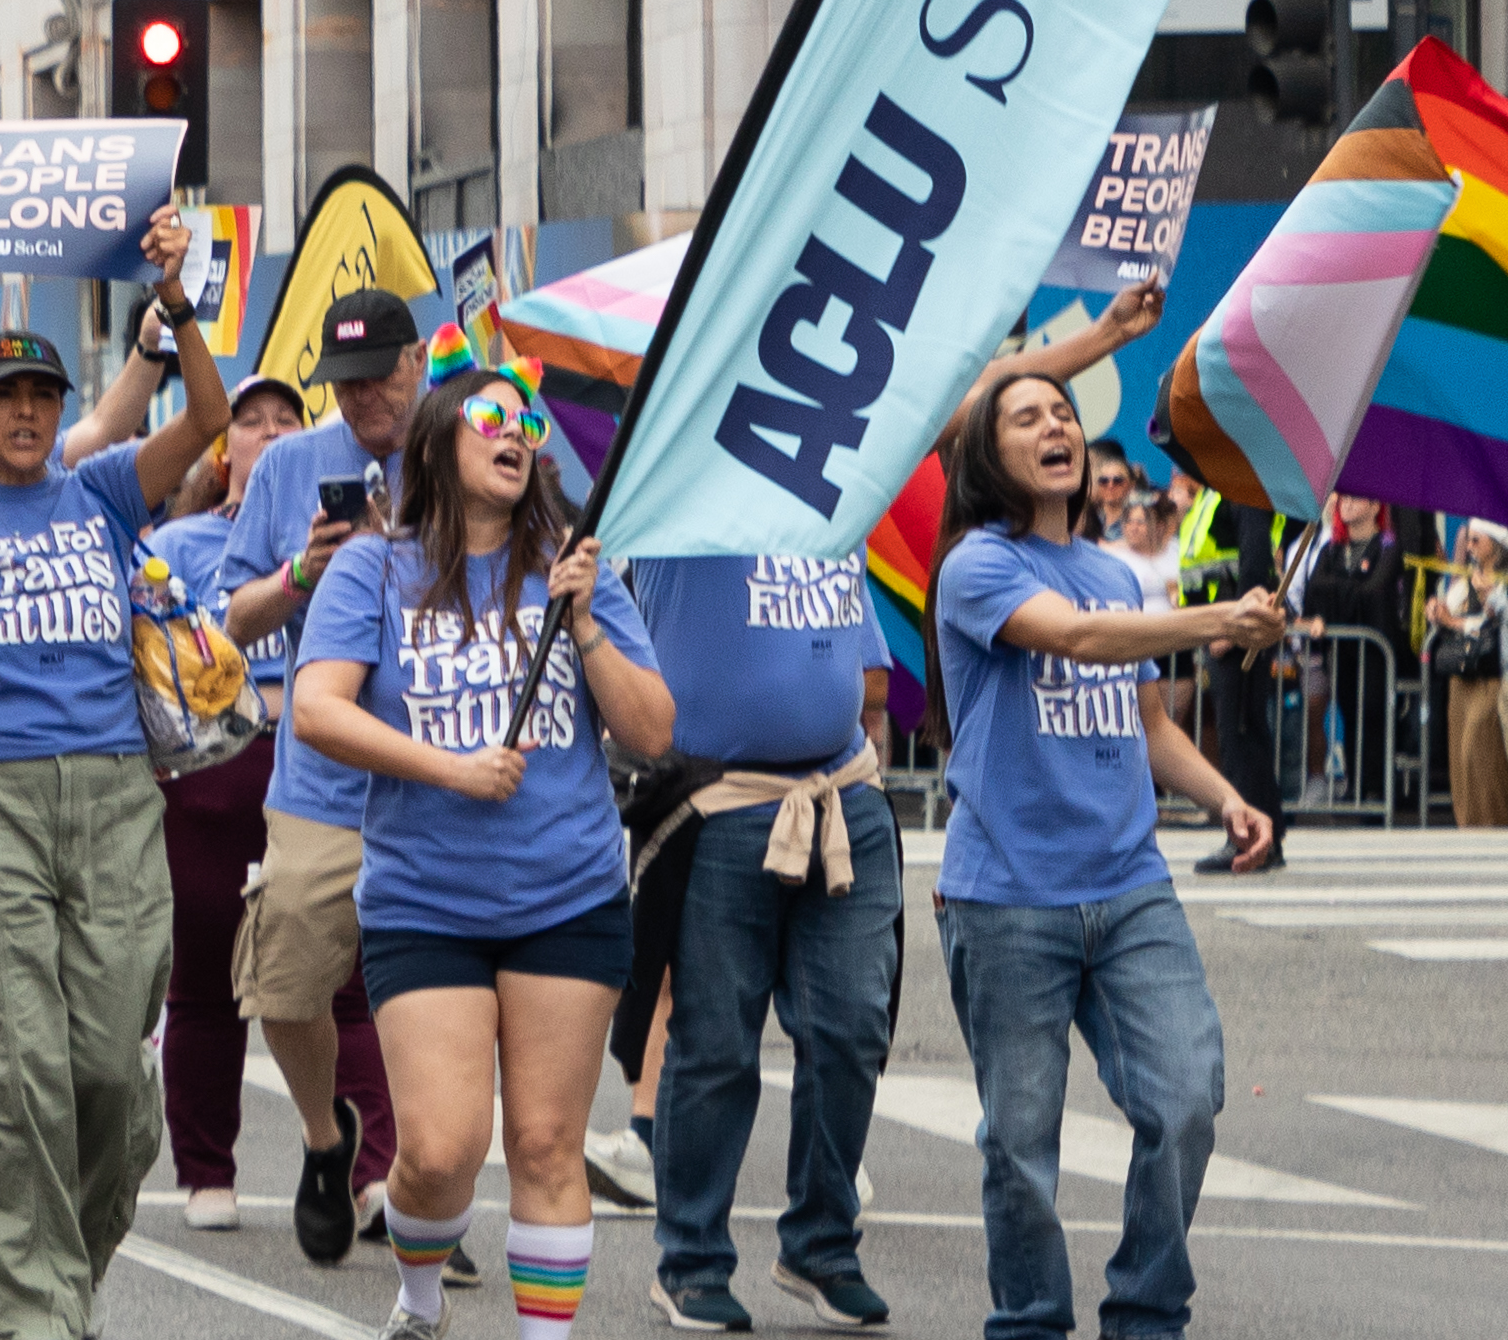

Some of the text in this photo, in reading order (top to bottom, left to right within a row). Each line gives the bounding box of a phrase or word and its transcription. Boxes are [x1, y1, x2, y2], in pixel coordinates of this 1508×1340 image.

[1109, 127, 1207, 175] TRANS
[1094, 172, 1197, 215] PEOPLE
[14, 239, 64, 258] SoCal
[1080, 211, 1184, 255] BELO
[713, 90, 967, 522] ACLU
[49, 515, 107, 555] For
[745, 572, 864, 631] Futures
[398, 640, 577, 695] Trans
[1031, 680, 1141, 739] Futur
